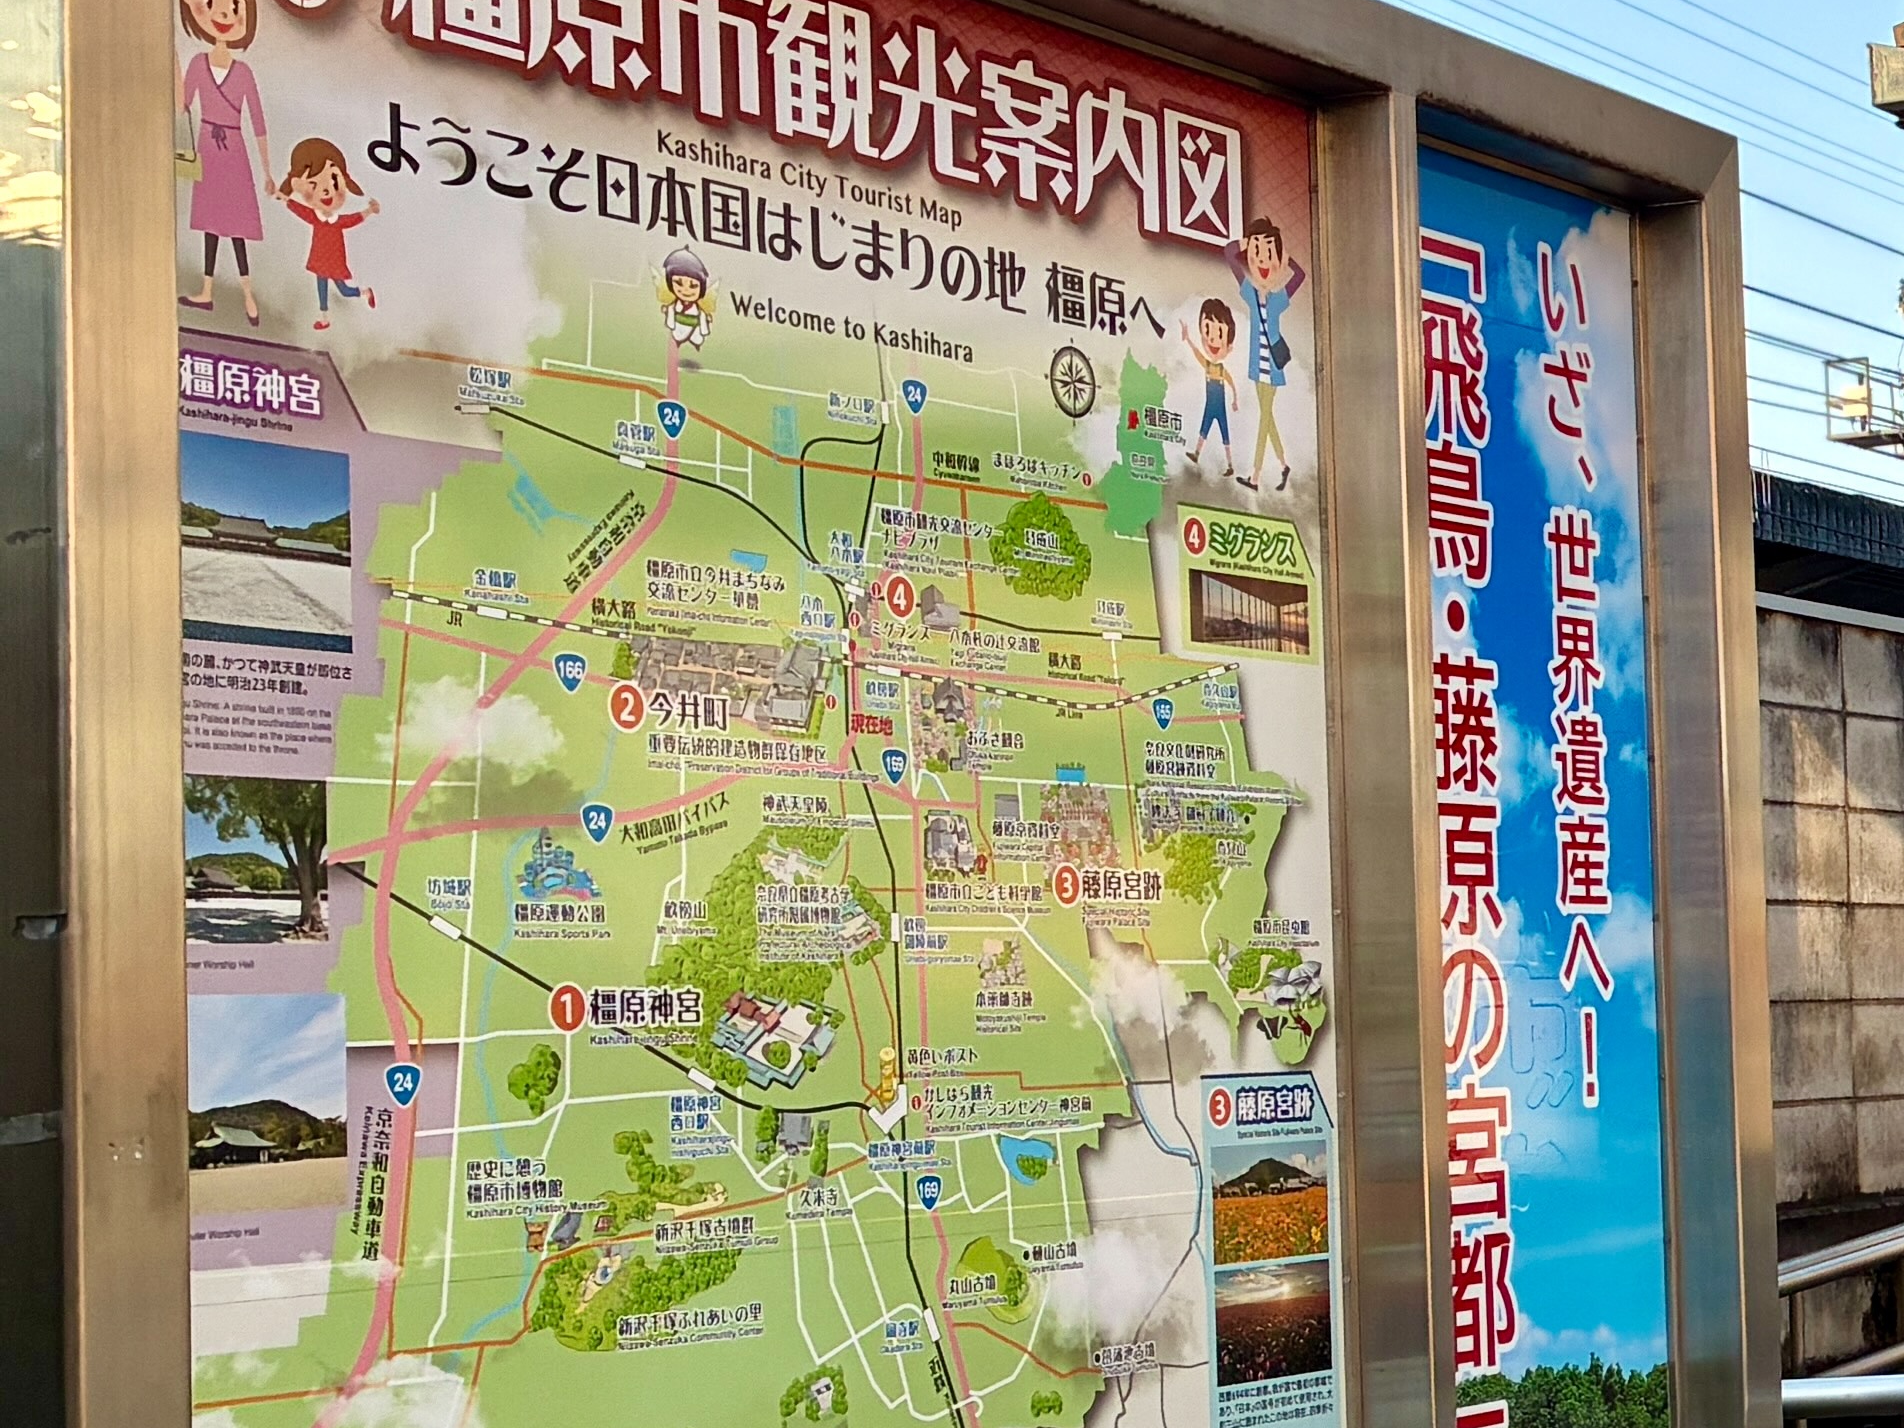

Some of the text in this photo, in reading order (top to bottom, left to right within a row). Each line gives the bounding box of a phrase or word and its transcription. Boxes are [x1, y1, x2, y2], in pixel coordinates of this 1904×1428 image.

[657, 129, 962, 231] Kashihara City Tourist Map
[367, 102, 1166, 340] ようこそ日本国はじまりの地 橿原へ
[730, 291, 974, 363] Welcome to Kashihara
[179, 354, 320, 415] 橿原神宮
[907, 385, 922, 402] 24
[663, 408, 681, 426] 24
[1188, 523, 1201, 550] 4
[1210, 523, 1297, 568] ミグランス
[893, 583, 908, 611] 4
[447, 610, 463, 627] JR
[558, 660, 583, 680] 166
[620, 691, 636, 722] 2
[649, 691, 729, 731] 今井町
[851, 713, 893, 736] 現在地
[589, 811, 607, 830] 24
[1061, 872, 1073, 899] 3
[1081, 870, 1162, 901] 藤原宮跡
[515, 903, 606, 923] 橿原運動公園
[559, 992, 573, 1024] 1
[590, 988, 701, 1025] 橿原神宮
[392, 1073, 413, 1092] 24
[1214, 1094, 1226, 1121] 3
[1237, 1087, 1313, 1122] 藤原宮跡
[467, 1159, 547, 1181] 歴史に憩う
[361, 1107, 394, 1262] 京奈和自動車道
[467, 1179, 564, 1205] 橿原市博物館
[800, 1187, 839, 1209] 久米寺
[918, 1182, 939, 1200] 169
[949, 1274, 997, 1296] 丸山古墳
